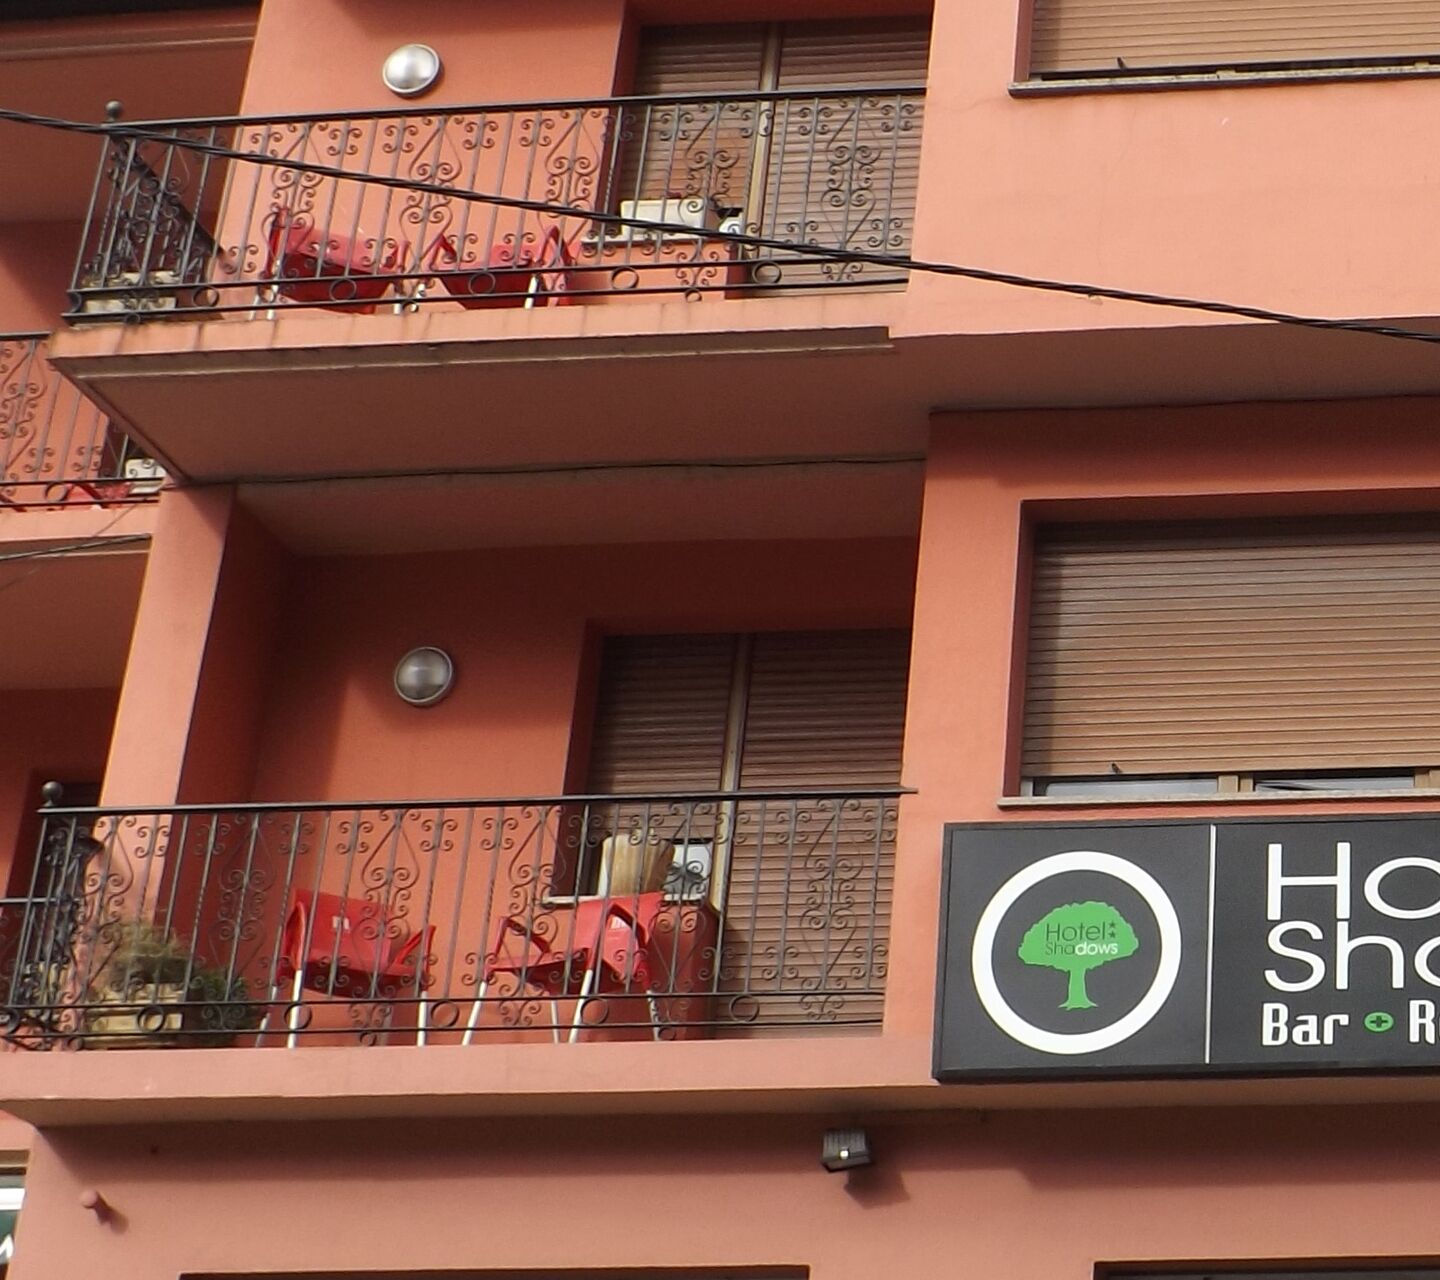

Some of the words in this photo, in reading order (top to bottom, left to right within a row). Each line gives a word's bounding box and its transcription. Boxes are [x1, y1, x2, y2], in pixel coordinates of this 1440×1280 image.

[1046, 922, 1105, 941] Hotel
[1045, 941, 1118, 956] Shadows
[1262, 1002, 1349, 1046] Bar
